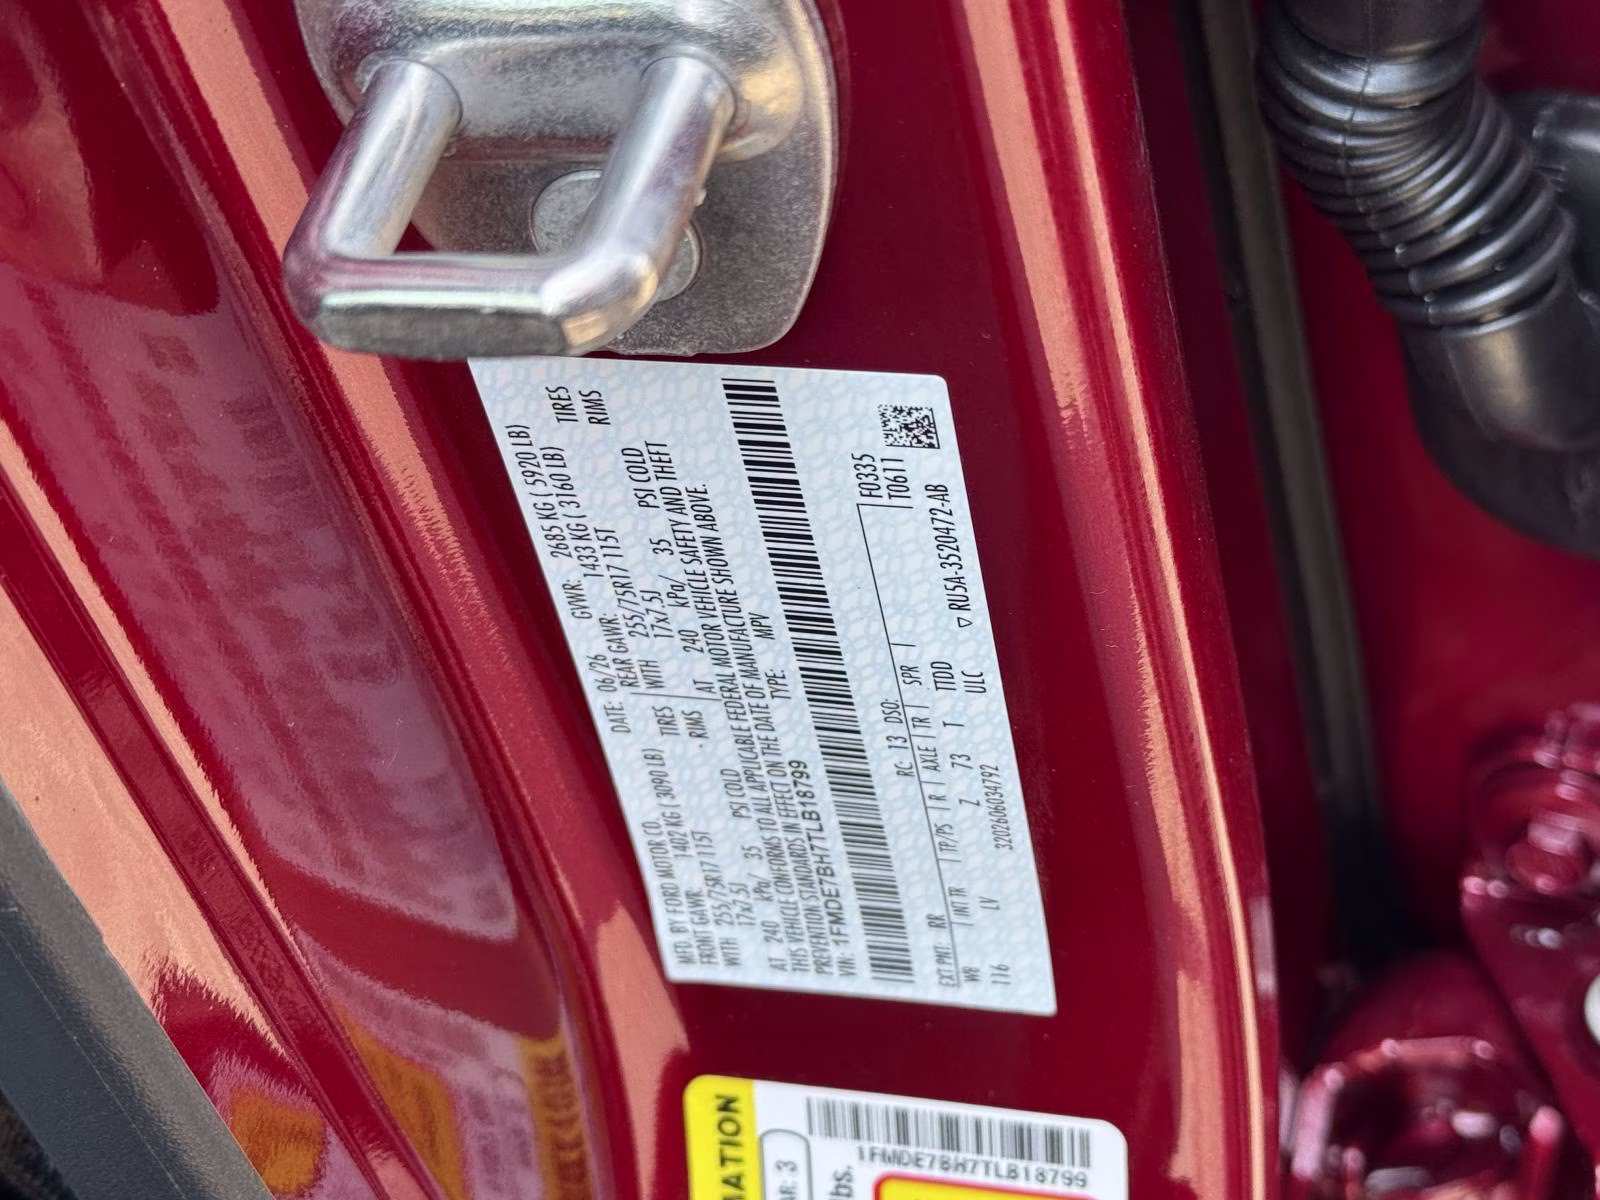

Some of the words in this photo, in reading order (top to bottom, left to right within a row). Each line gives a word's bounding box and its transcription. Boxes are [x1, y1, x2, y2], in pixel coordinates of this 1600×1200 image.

[545, 385, 580, 423] TIRES
[578, 389, 611, 425] RIMS
[503, 423, 535, 447] LB)
[513, 451, 548, 486] 5920
[539, 445, 569, 468] LB)
[619, 446, 652, 483] COLD
[643, 440, 677, 481] THEFT
[548, 472, 581, 508] 3160
[850, 452, 884, 497] F0335
[879, 456, 912, 499] T0611
[532, 500, 559, 520] KG
[633, 487, 660, 508] PSI
[657, 484, 687, 514] AND
[683, 482, 719, 532] ABOVE.
[540, 523, 573, 559] 2685
[565, 521, 592, 541] KG
[594, 526, 625, 558] 115T
[648, 537, 675, 556] 35
[667, 518, 703, 565] SAFETY
[573, 544, 605, 578] 1433
[699, 535, 734, 584] SHOWN
[923, 483, 972, 611] RU5A-3520472-AB
[559, 577, 593, 619] GVWR:
[606, 564, 651, 638] 255/75R17
[658, 574, 692, 608] kPa/
[682, 568, 718, 619] VEHICLE
[640, 588, 675, 639] 17x7.5J
[747, 611, 775, 639] MPV
[596, 612, 629, 653] GAWR:
[676, 628, 704, 653] 240
[699, 623, 733, 667] MOTOR
[714, 587, 761, 680] MANUFACTURE
[585, 653, 619, 692] 06/26
[611, 656, 640, 687] REAR
[636, 658, 666, 690] WITH
[691, 678, 717, 694] AT
[763, 667, 793, 700] TYPE:
[899, 663, 923, 685] SPR
[960, 669, 987, 693] ULC
[714, 670, 749, 722] FEDERAL
[741, 682, 766, 699] OF
[601, 699, 632, 733] DATE:
[652, 705, 682, 737] TIRES
[680, 708, 709, 739] RIMS
[747, 702, 776, 732] DATE
[878, 697, 903, 723] DSO:
[910, 715, 931, 729] TR
[942, 721, 965, 729] T
[640, 747, 668, 767] LB)
[756, 734, 782, 757] THE
[885, 734, 909, 750] 13
[730, 725, 768, 792] APPLICABLE
[763, 760, 788, 778] ON
[893, 759, 915, 777] RC:
[916, 744, 940, 772] AXLE
[948, 752, 974, 770] 73
[647, 769, 675, 798] 3090
[719, 767, 747, 798] COLD
[927, 793, 947, 801] R
[728, 801, 753, 819] PSI
[749, 794, 774, 814] ALL
[769, 780, 799, 818] EFFECT
[958, 797, 981, 806] Z
[979, 763, 1013, 850] 3202606034792
[640, 816, 664, 836] CO.
[660, 810, 684, 827] KG
[756, 817, 779, 832] TO
[780, 820, 803, 834] IN
[666, 829, 694, 859] 1402
[690, 829, 716, 856] 115T
[740, 844, 764, 860] 35
[786, 758, 853, 946] 1FMDE7BH7TLB18799
[933, 822, 959, 853] TP/PS
[646, 838, 677, 879] MOTOR
[761, 834, 796, 895] CONFORMS
[785, 836, 821, 902] STANDARDS
[659, 881, 685, 914] FORD
[699, 860, 736, 927] 255/75R17
[747, 871, 774, 902] kPa/
[946, 885, 966, 898] TR
[727, 881, 757, 927] 17x7.5J
[949, 898, 969, 917] INT
[979, 895, 1000, 910] LV
[667, 917, 689, 934] BY
[761, 919, 784, 944] 240
[777, 897, 807, 945] VEHICLE
[926, 912, 947, 929] RR
[694, 928, 719, 965] FRONT
[719, 936, 743, 967] WITH
[802, 904, 837, 975] PREVENTION
[767, 955, 789, 971] AT
[788, 947, 811, 973] THIS
[835, 951, 859, 977] VIN:
[962, 965, 981, 982] WB
[989, 962, 1012, 985] 116
[774, 1160, 797, 1172] 3
[856, 1145, 1088, 1188] 1FMDE7BH7TLB18799
